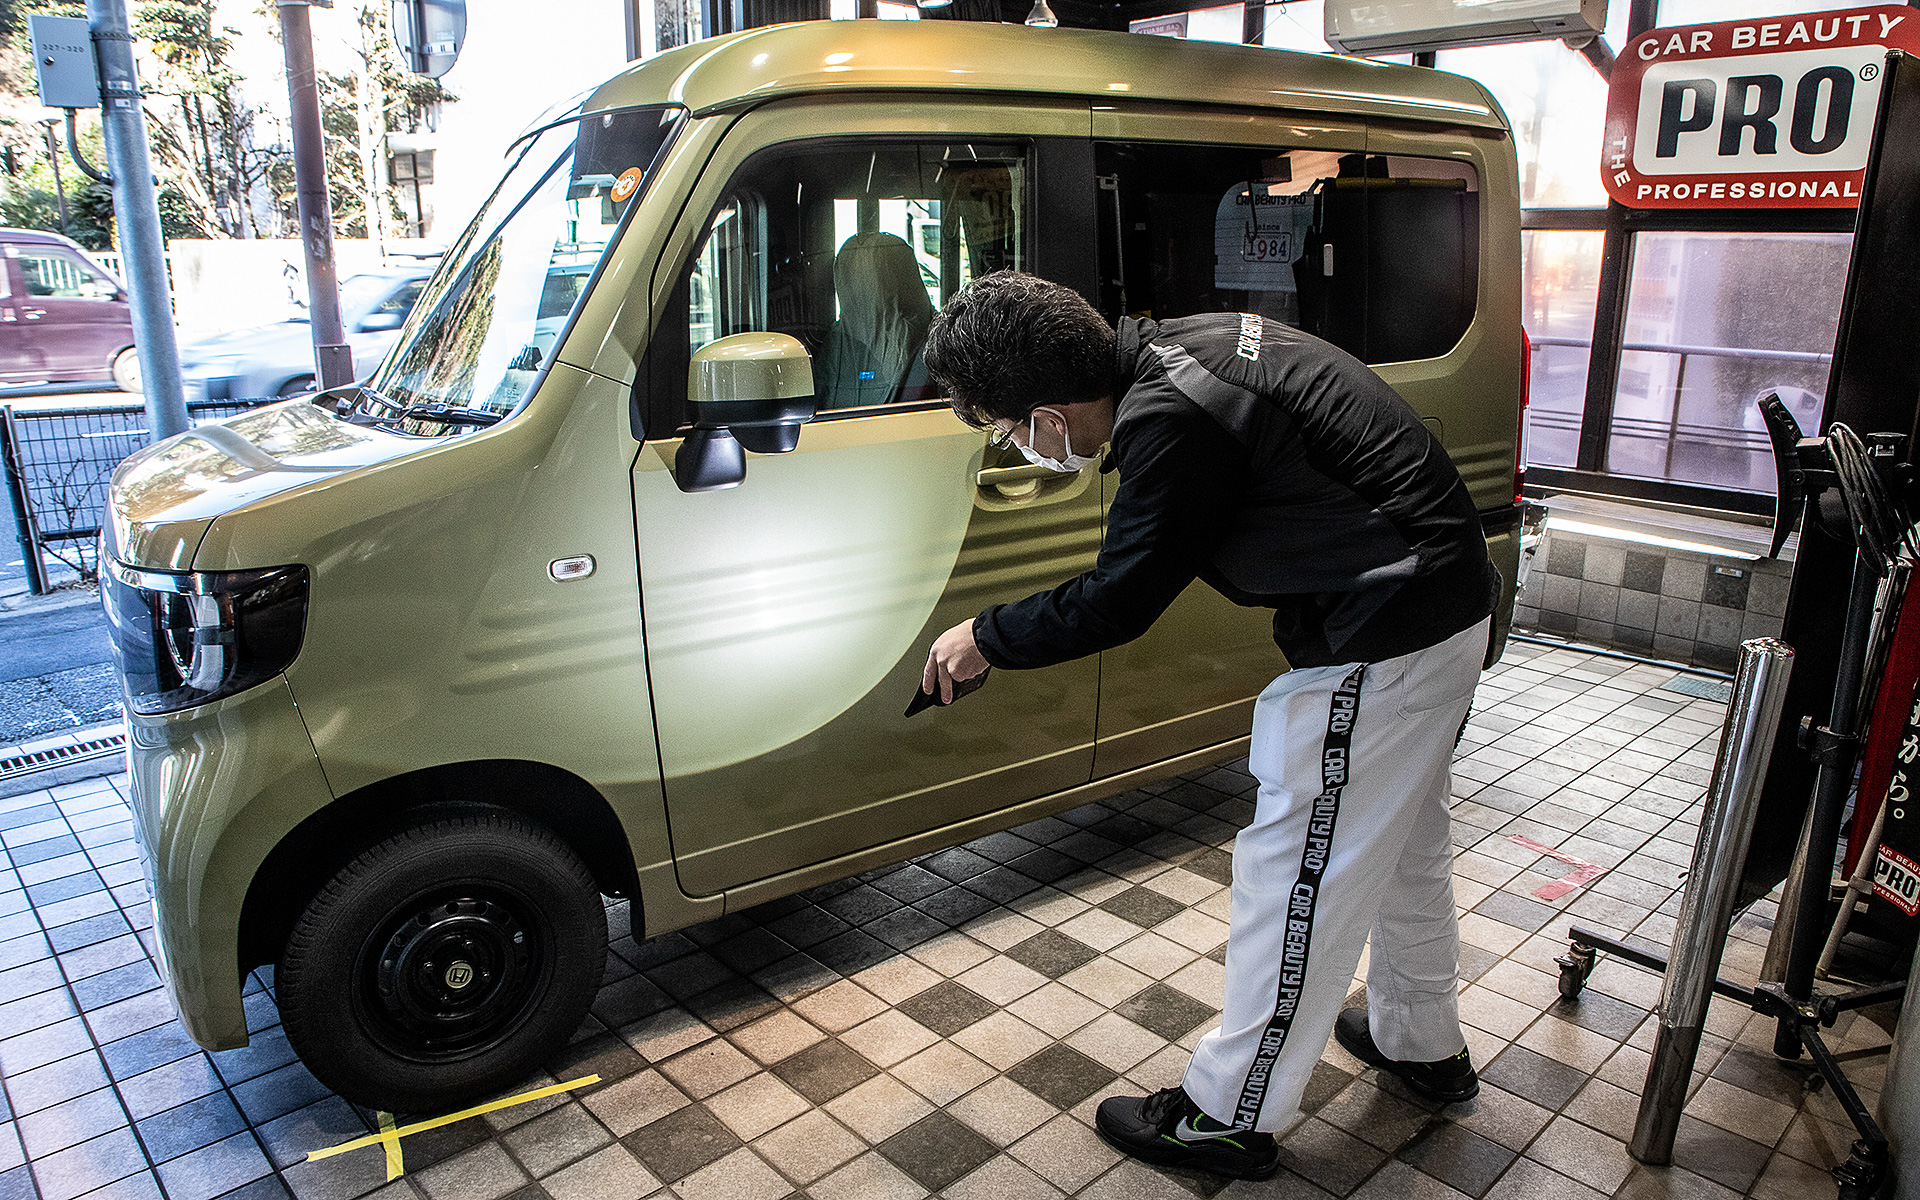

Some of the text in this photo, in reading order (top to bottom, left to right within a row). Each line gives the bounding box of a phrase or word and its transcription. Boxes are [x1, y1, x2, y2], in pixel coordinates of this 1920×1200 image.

[1638, 13, 1906, 61] CAR BEAUTY
[1610, 136, 1632, 188] THE
[1255, 194, 1287, 206] BEAUTY
[1636, 180, 1860, 200] PROFESSIONAL
[1247, 240, 1287, 260] 1984
[1236, 335, 1261, 361] CAR
[1325, 747, 1345, 785] CAR
[1889, 698, 1920, 820] から。
[1311, 787, 1338, 836] EAUTY
[1290, 883, 1314, 918] CAR
[1281, 919, 1309, 985] BEAUTY
[1259, 1027, 1285, 1056] CAR
[1240, 1057, 1275, 1109] BEAUTY
